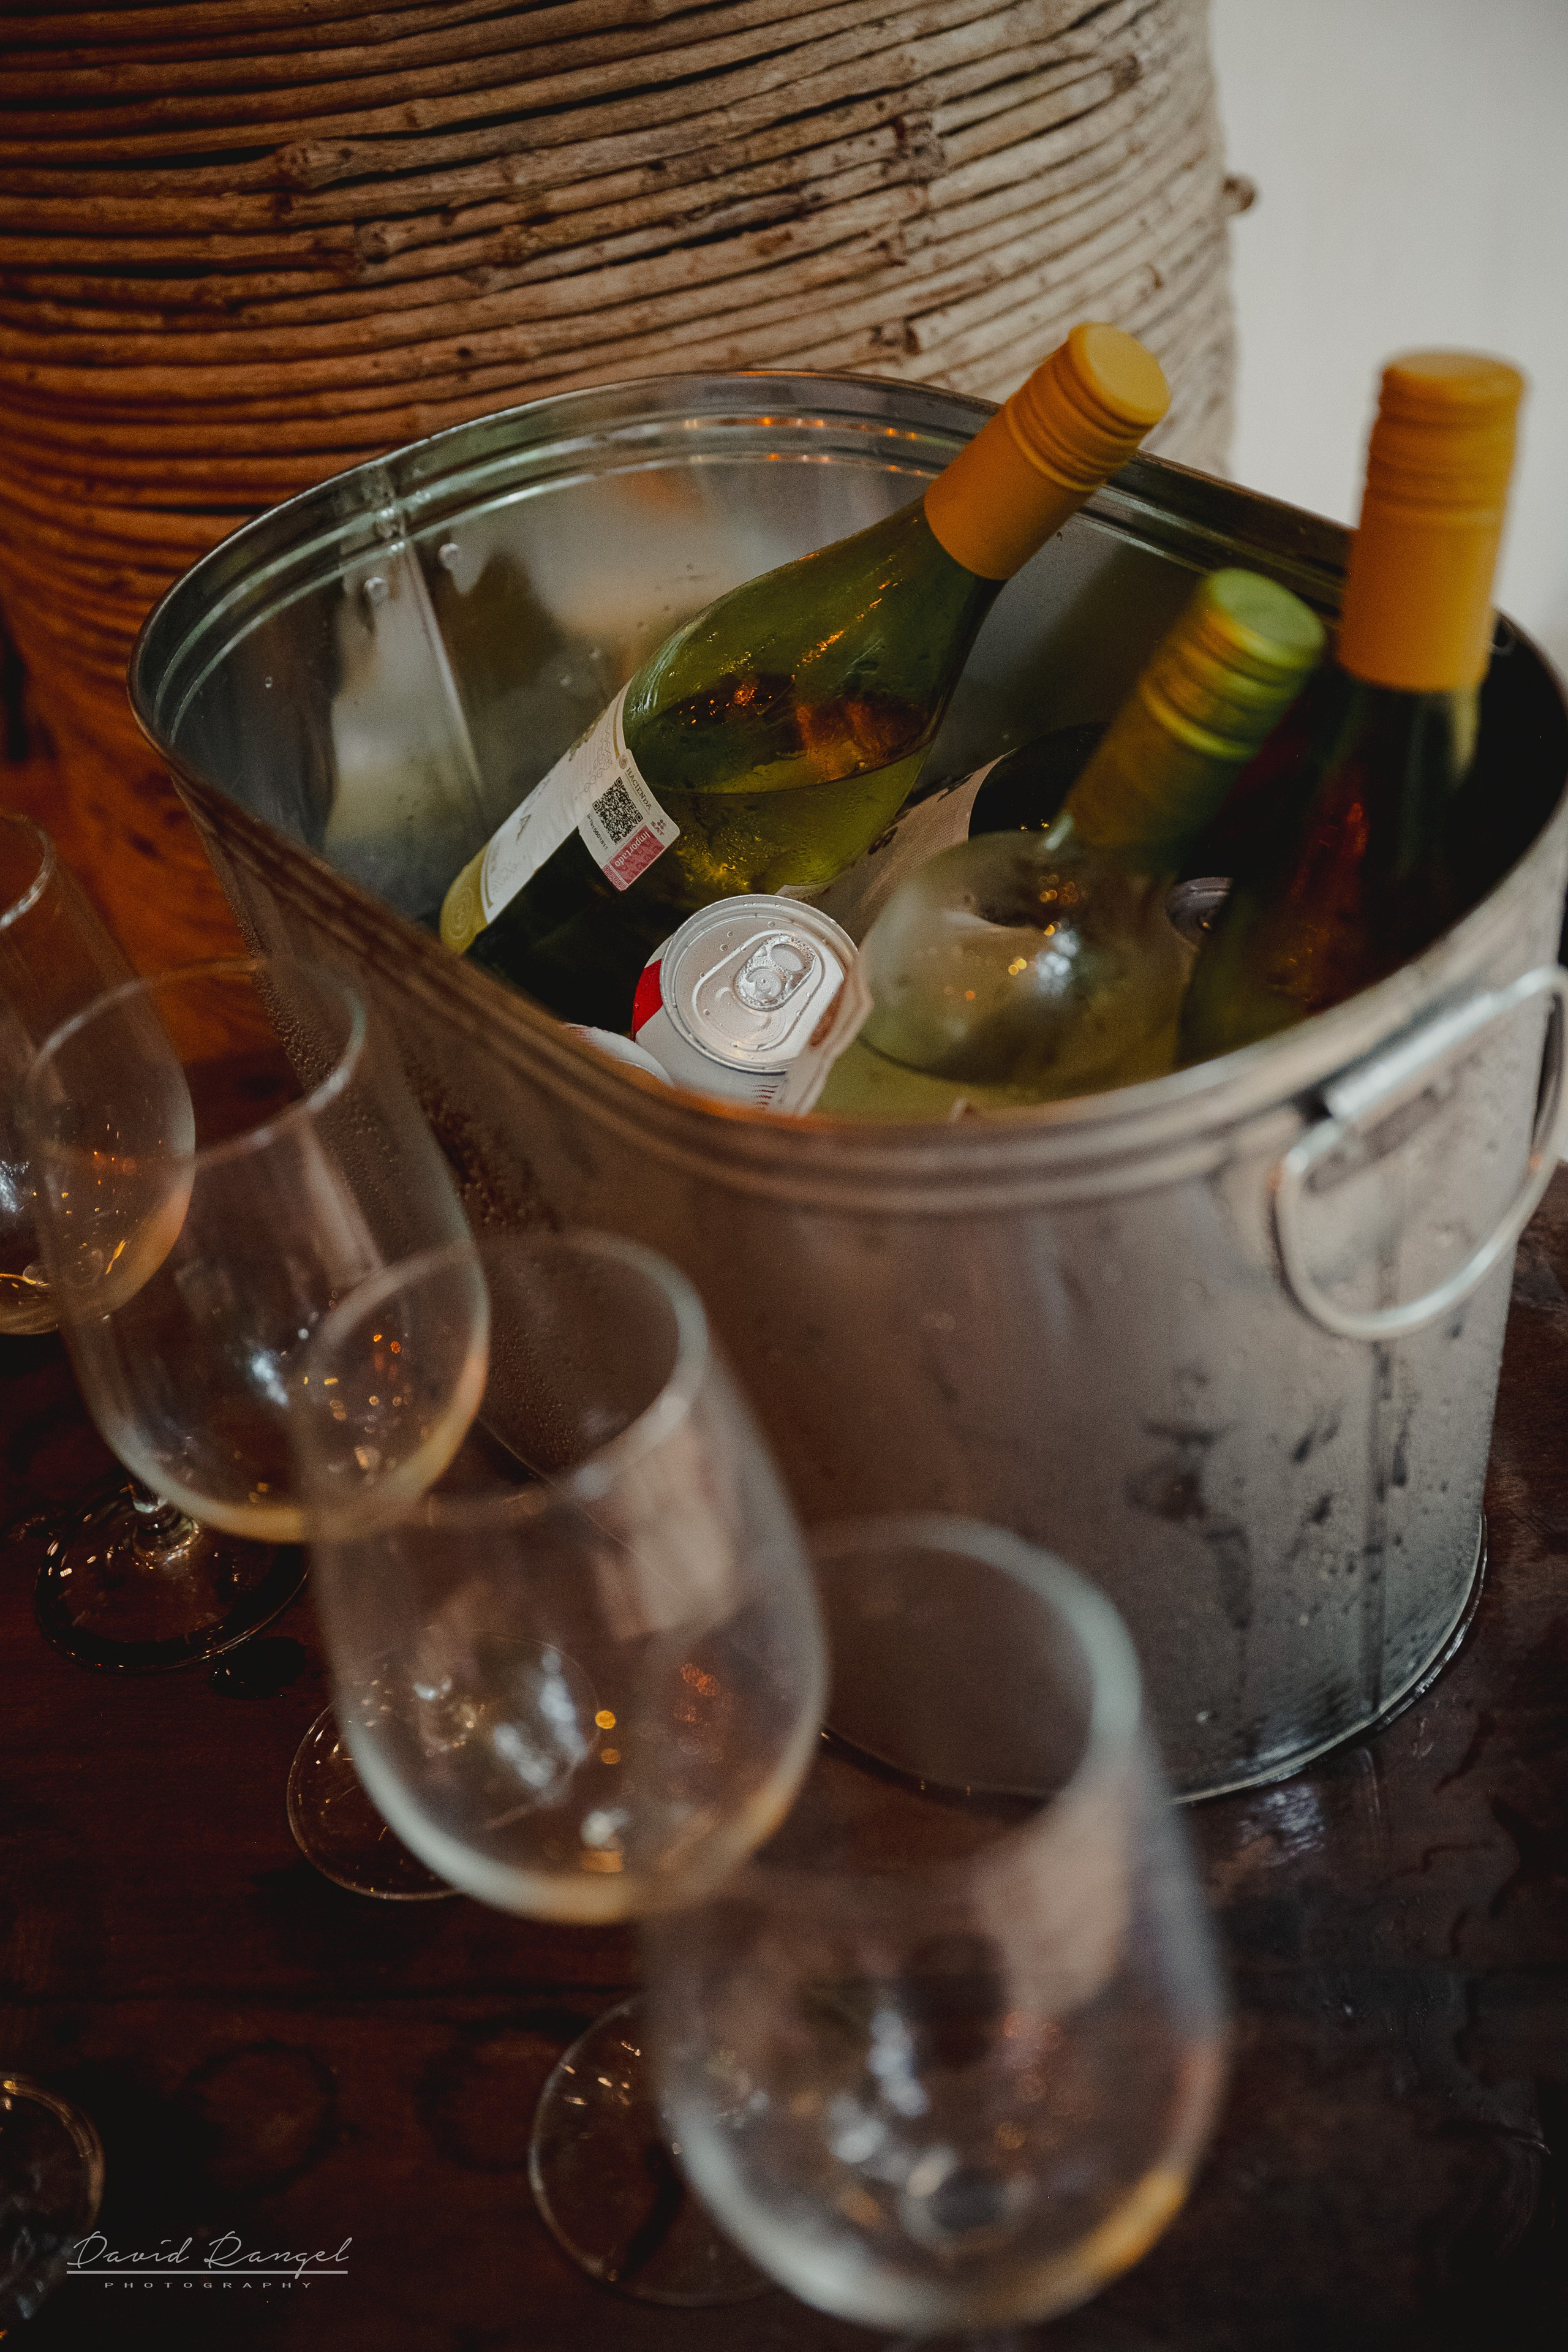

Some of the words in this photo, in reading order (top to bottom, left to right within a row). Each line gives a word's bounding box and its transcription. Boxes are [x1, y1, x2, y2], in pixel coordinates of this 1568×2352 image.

[626, 768, 652, 810] HACIENDA
[650, 821, 665, 835] SAT
[614, 831, 650, 867] Importado
